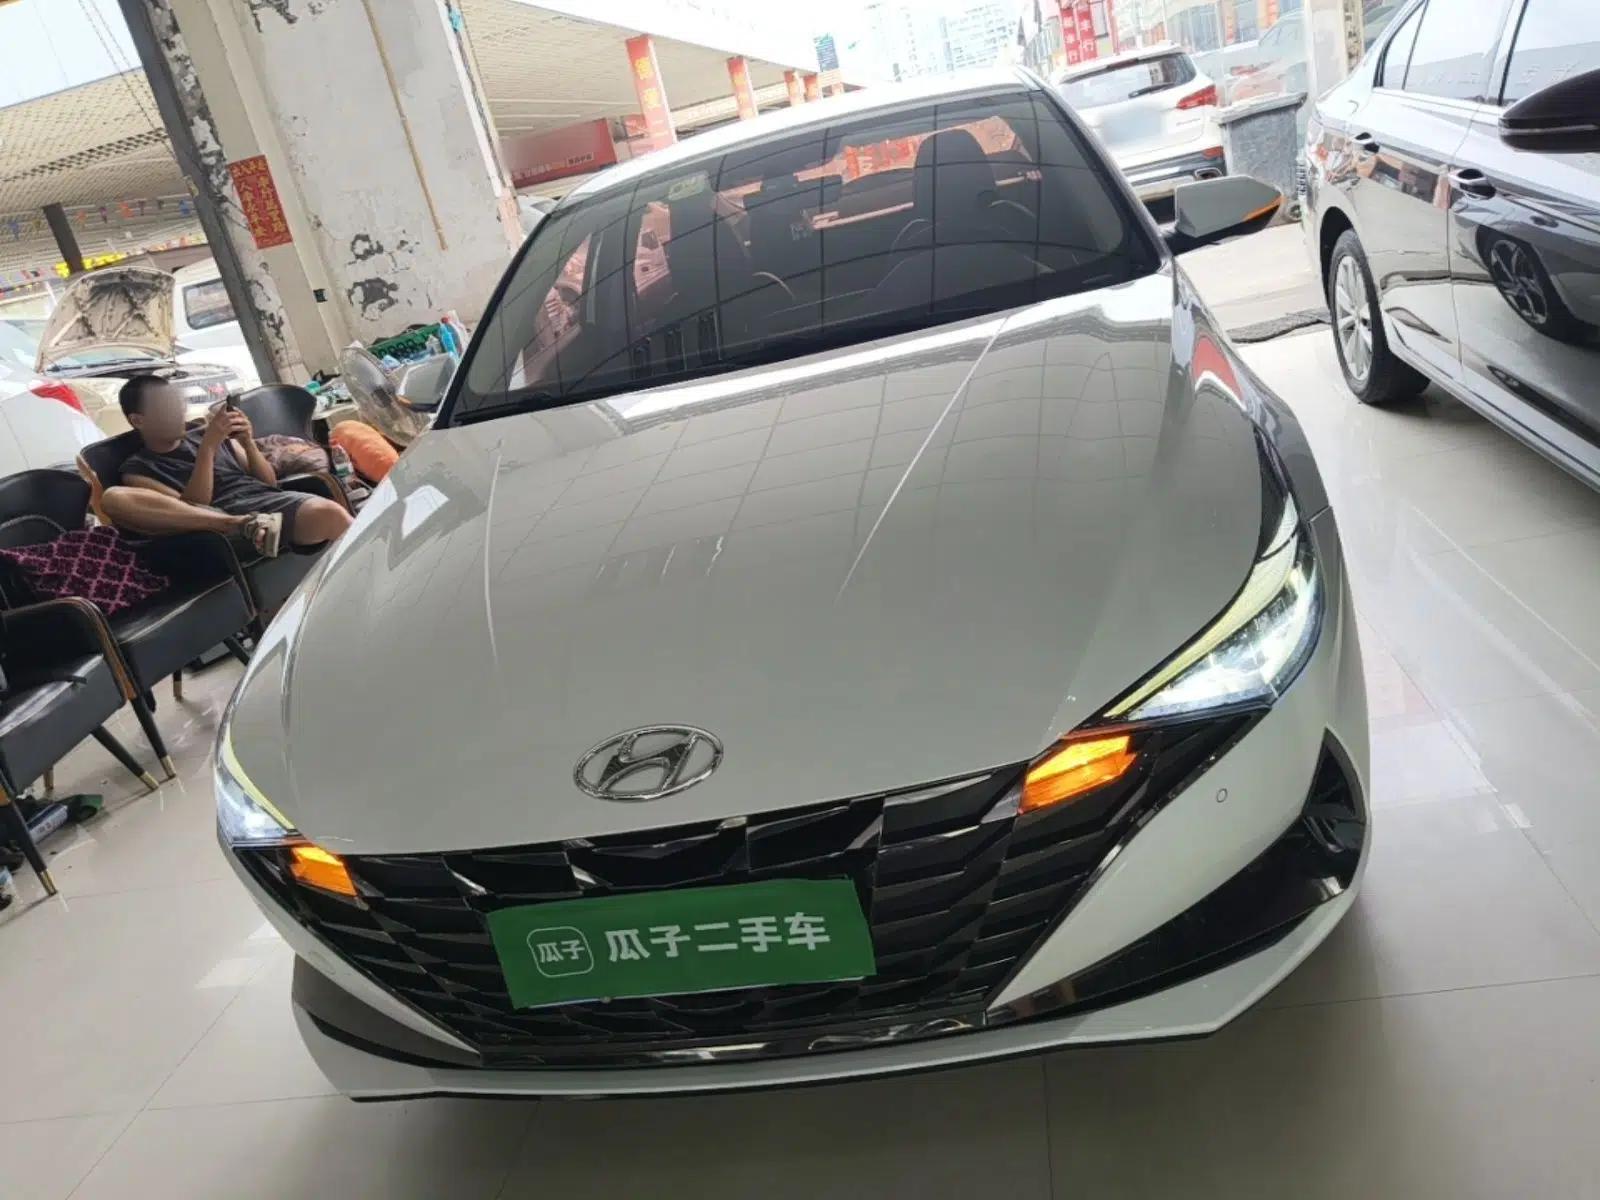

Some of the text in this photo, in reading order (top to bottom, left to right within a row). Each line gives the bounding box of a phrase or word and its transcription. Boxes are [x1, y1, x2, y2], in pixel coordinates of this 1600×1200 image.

[536, 939, 585, 963] 瓜子
[605, 912, 831, 962] 瓜子二手车
